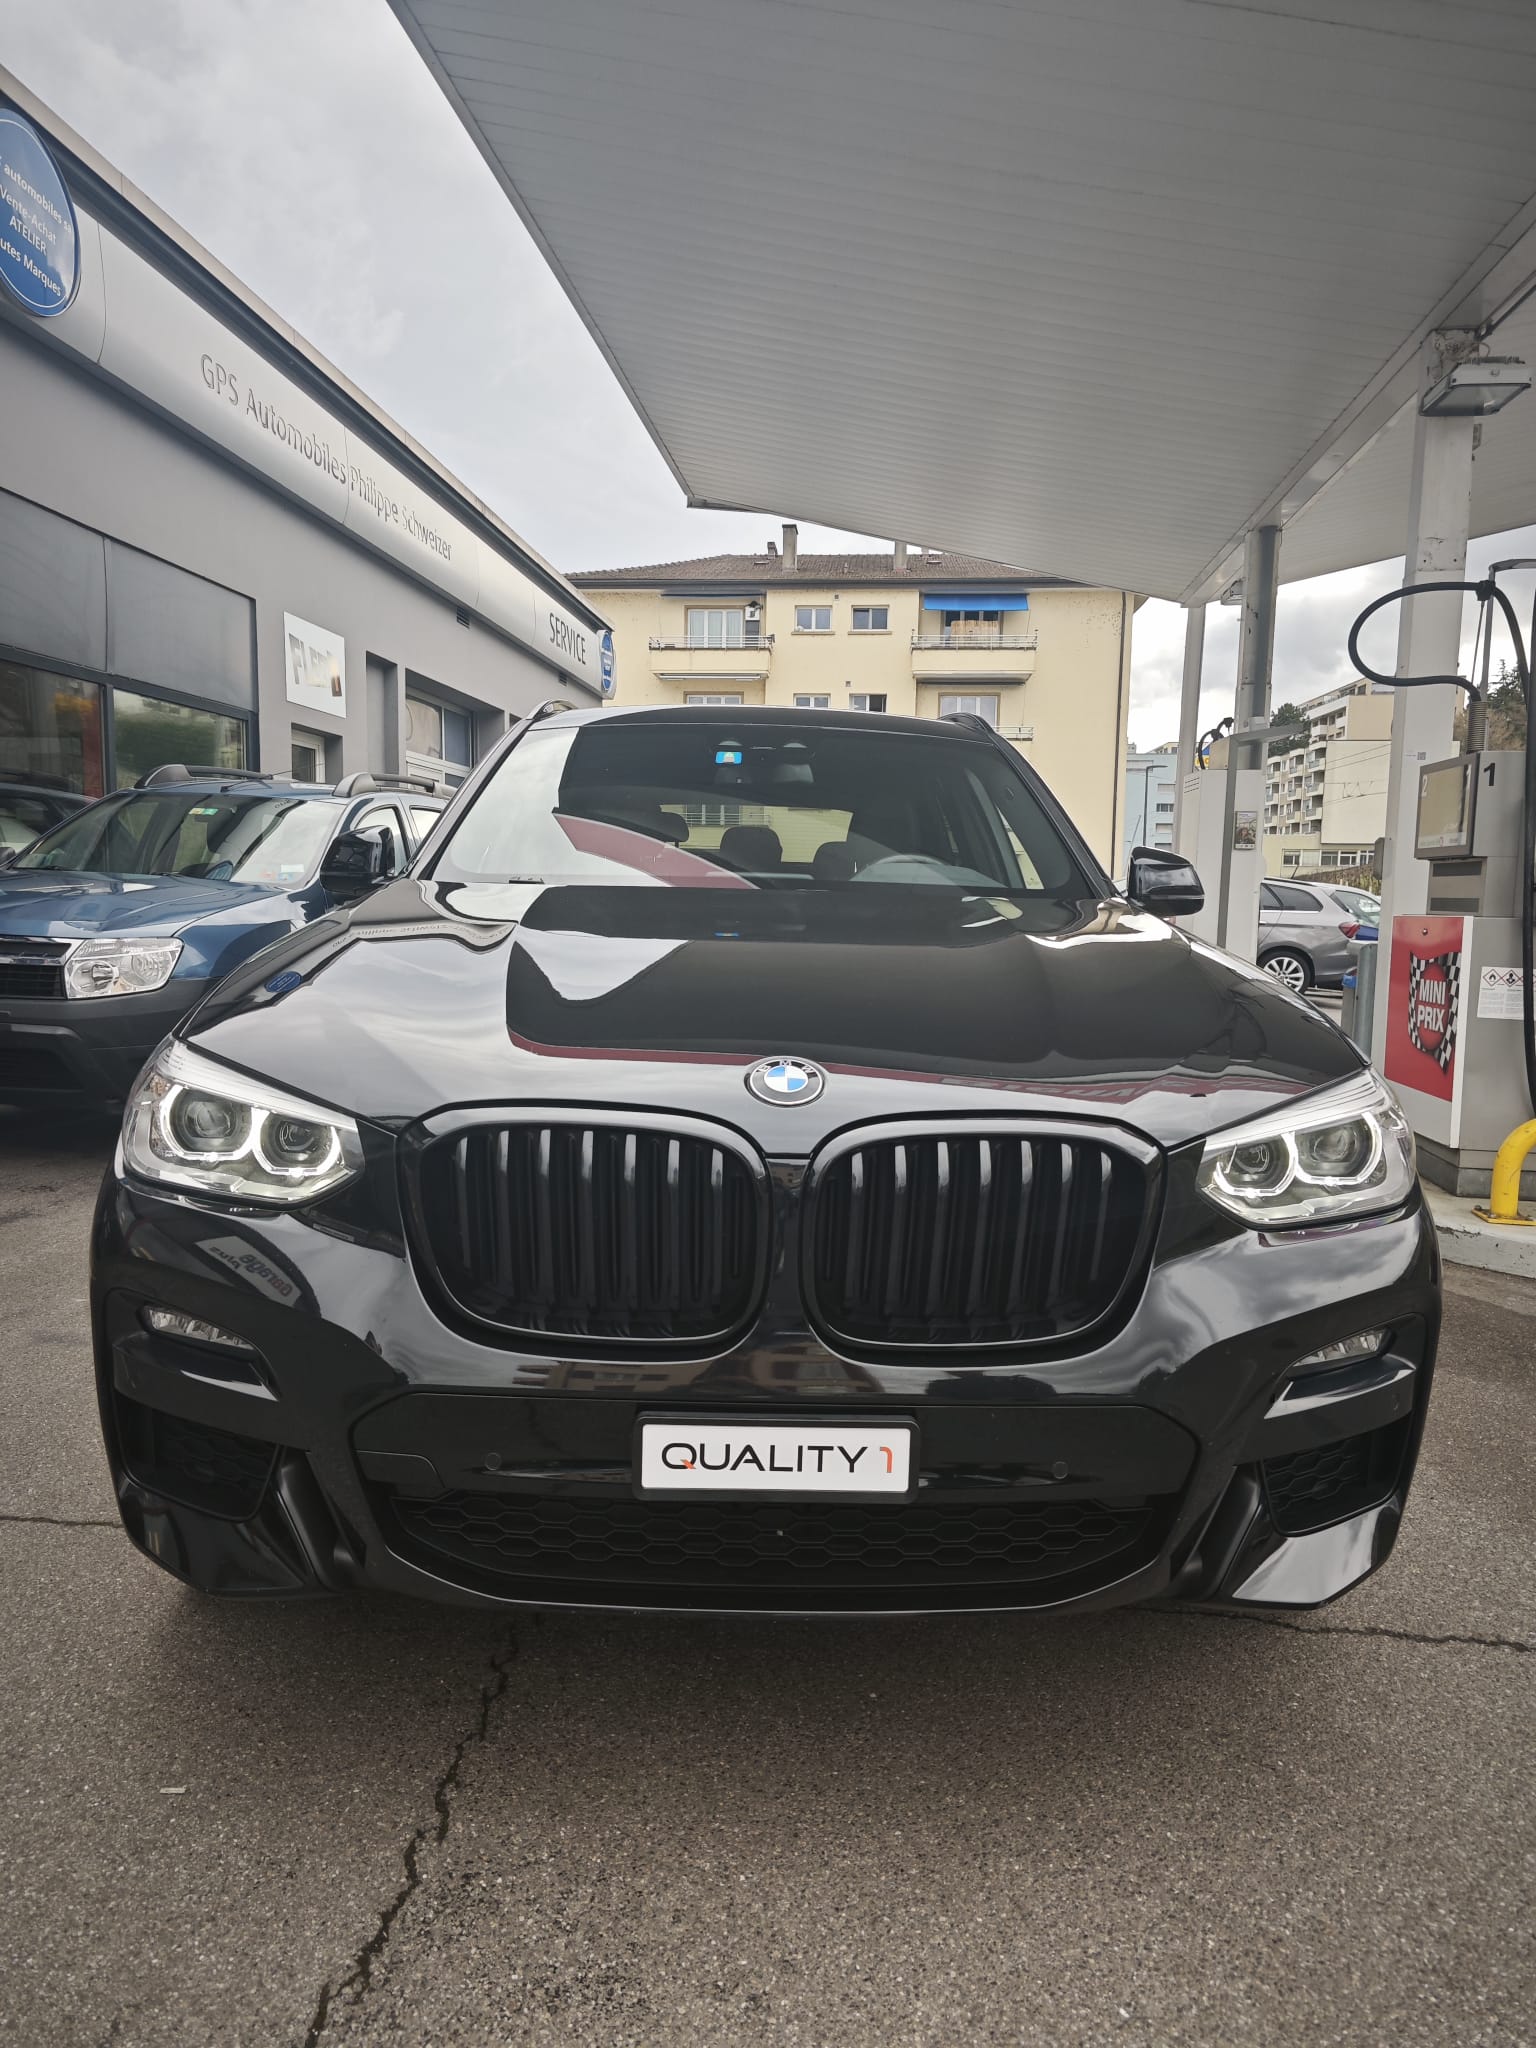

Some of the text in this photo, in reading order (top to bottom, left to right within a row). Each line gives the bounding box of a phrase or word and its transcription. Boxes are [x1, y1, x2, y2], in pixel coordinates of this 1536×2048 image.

[4, 163, 63, 225] automobiles
[0, 184, 57, 246] Vente-Achat
[9, 215, 48, 257] ATELIER
[23, 254, 61, 297] Marques
[201, 354, 453, 561] GPS Automobiles Philippe Schweizer
[549, 612, 587, 666] SERVICE
[1421, 775, 1428, 797] 2
[1483, 762, 1496, 787] 1
[1419, 978, 1447, 1006] MINI
[1416, 1005, 1446, 1033] PRIX
[756, 1060, 817, 1074] BMW
[661, 1442, 869, 1474] QUALITY
